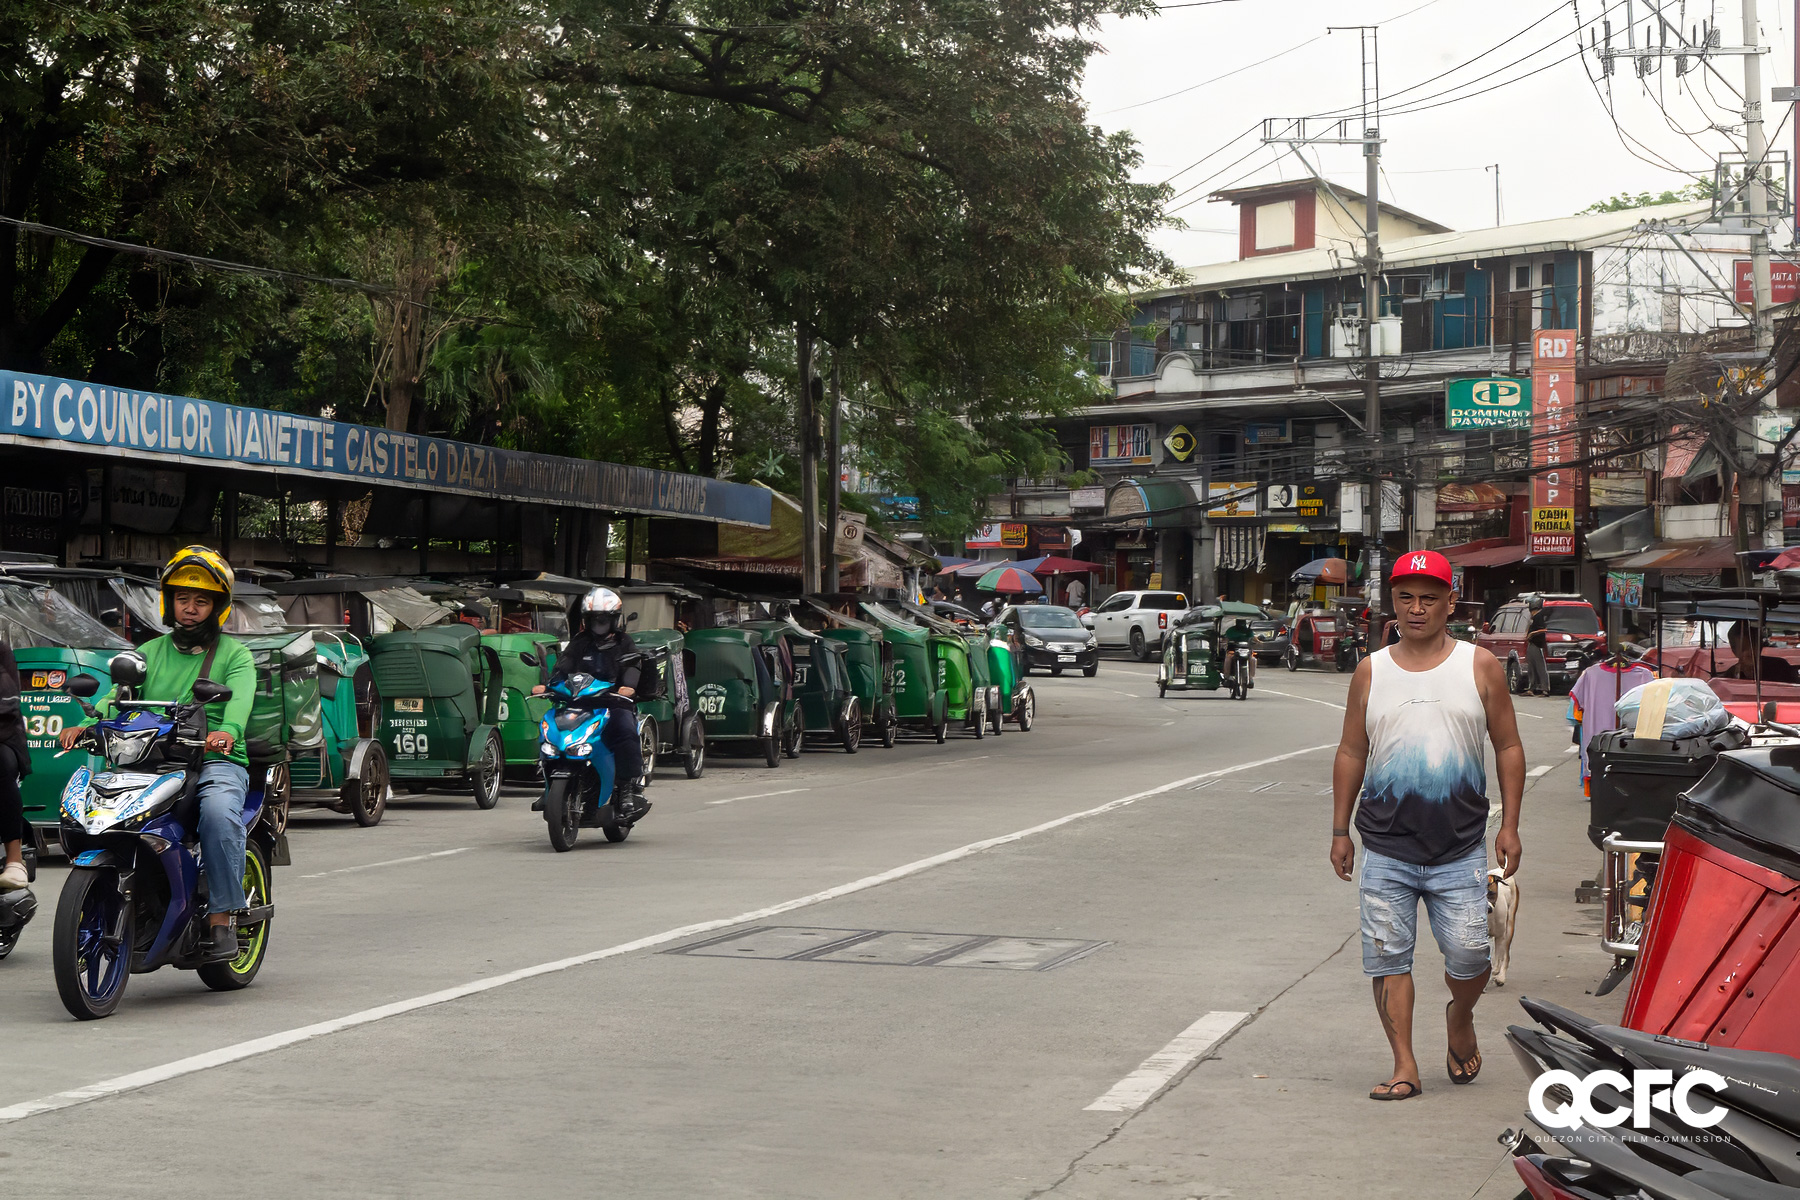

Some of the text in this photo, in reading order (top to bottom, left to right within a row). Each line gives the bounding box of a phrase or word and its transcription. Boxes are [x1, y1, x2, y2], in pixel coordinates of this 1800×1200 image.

[1539, 338, 1568, 358] RD
[12, 380, 45, 429] BY
[53, 382, 214, 454] COUNCILOR
[225, 407, 335, 468] NANETTE
[345, 427, 438, 481] CASTELO
[446, 443, 497, 489] DAZA
[1534, 521, 1571, 531] PADALA
[1533, 535, 1572, 545] MONEY
[393, 733, 429, 753] 160
